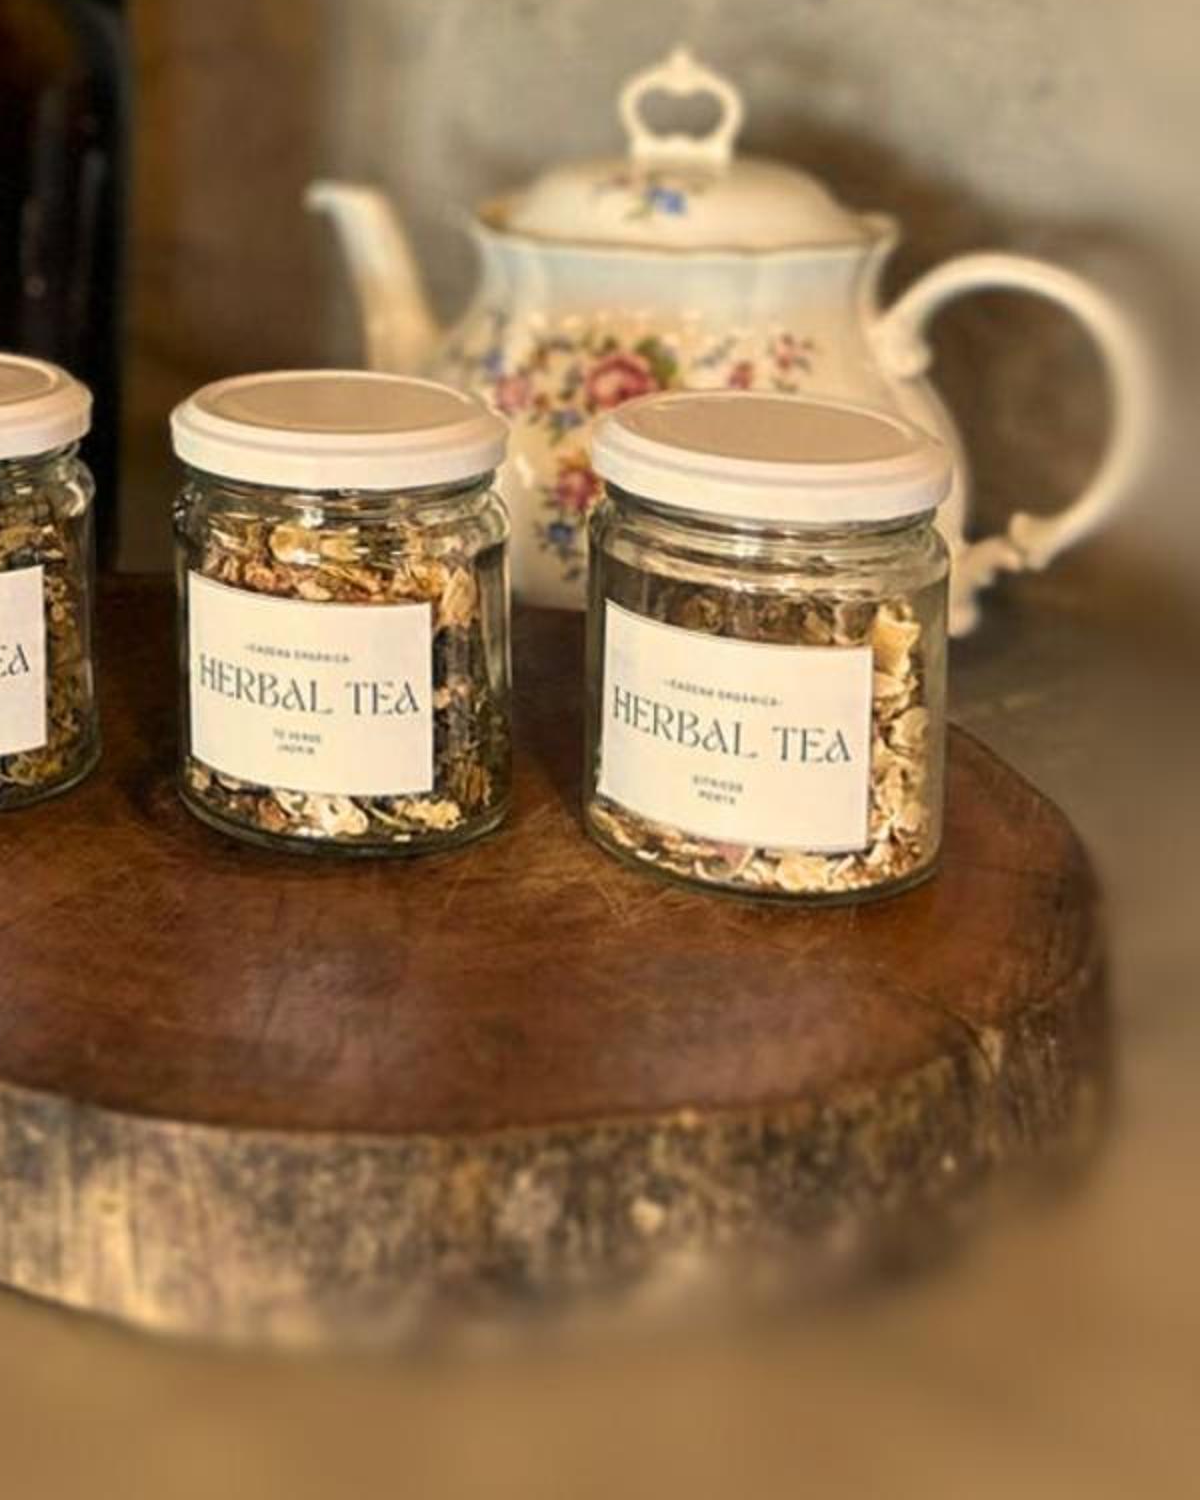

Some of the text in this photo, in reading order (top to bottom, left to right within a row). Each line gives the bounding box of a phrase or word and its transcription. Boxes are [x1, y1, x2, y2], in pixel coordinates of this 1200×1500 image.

[199, 653, 420, 716] HERBAL TEA
[612, 684, 852, 763] HERBAL TEA
